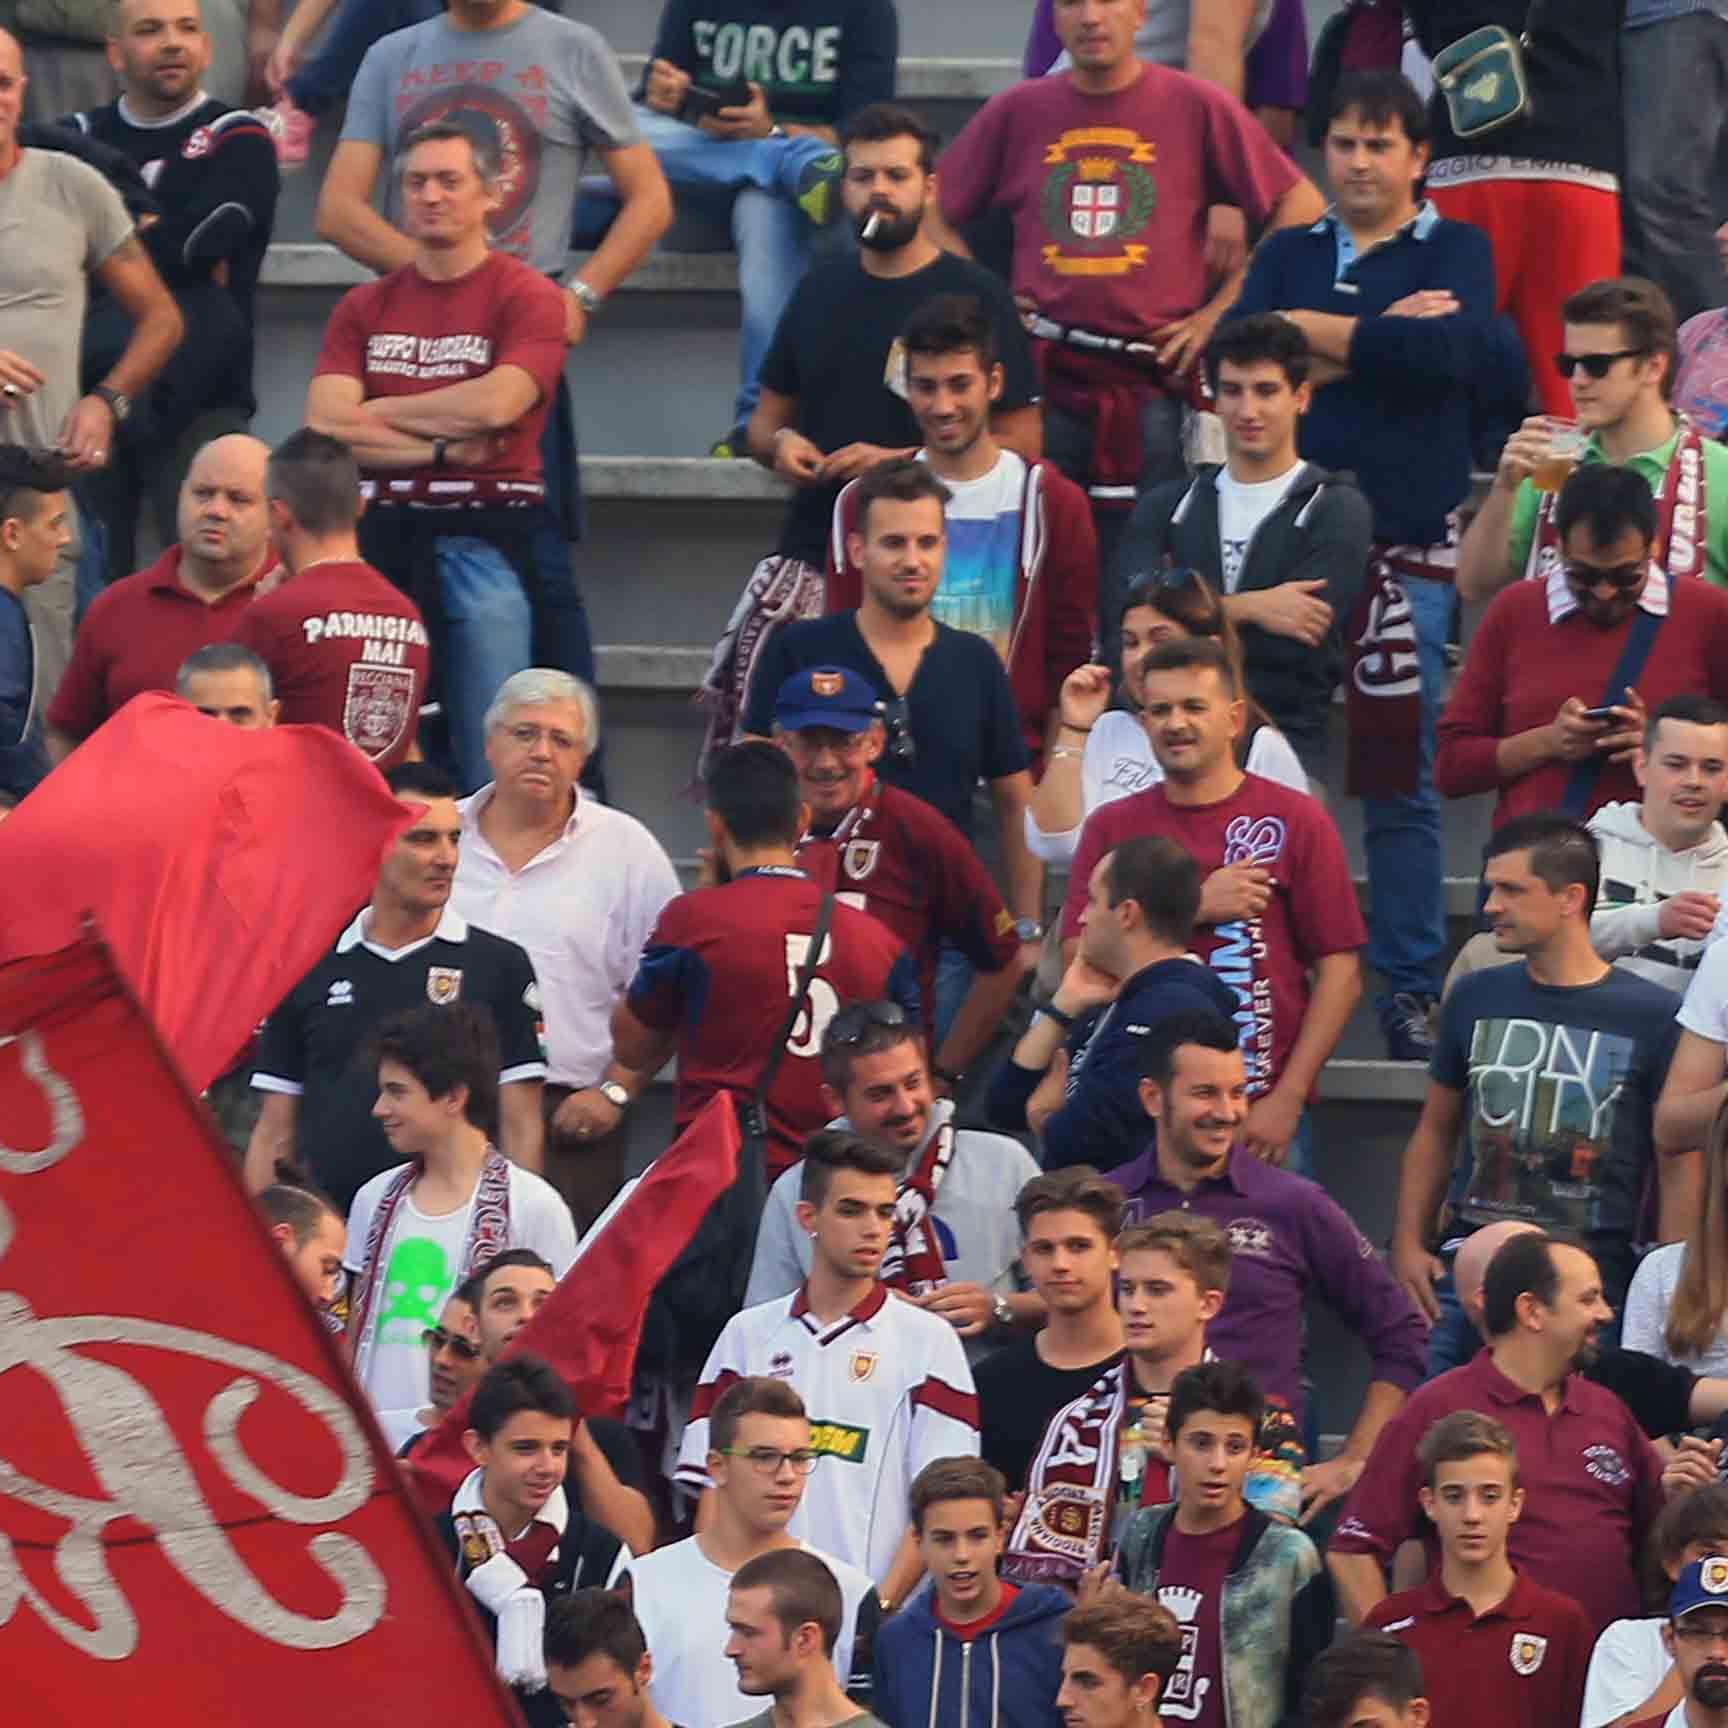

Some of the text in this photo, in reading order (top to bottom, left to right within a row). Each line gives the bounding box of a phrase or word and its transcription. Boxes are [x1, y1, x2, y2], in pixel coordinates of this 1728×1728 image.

[362, 638, 405, 666] MAI
[784, 931, 840, 1058] 5
[1477, 1065, 1624, 1140] CITY
